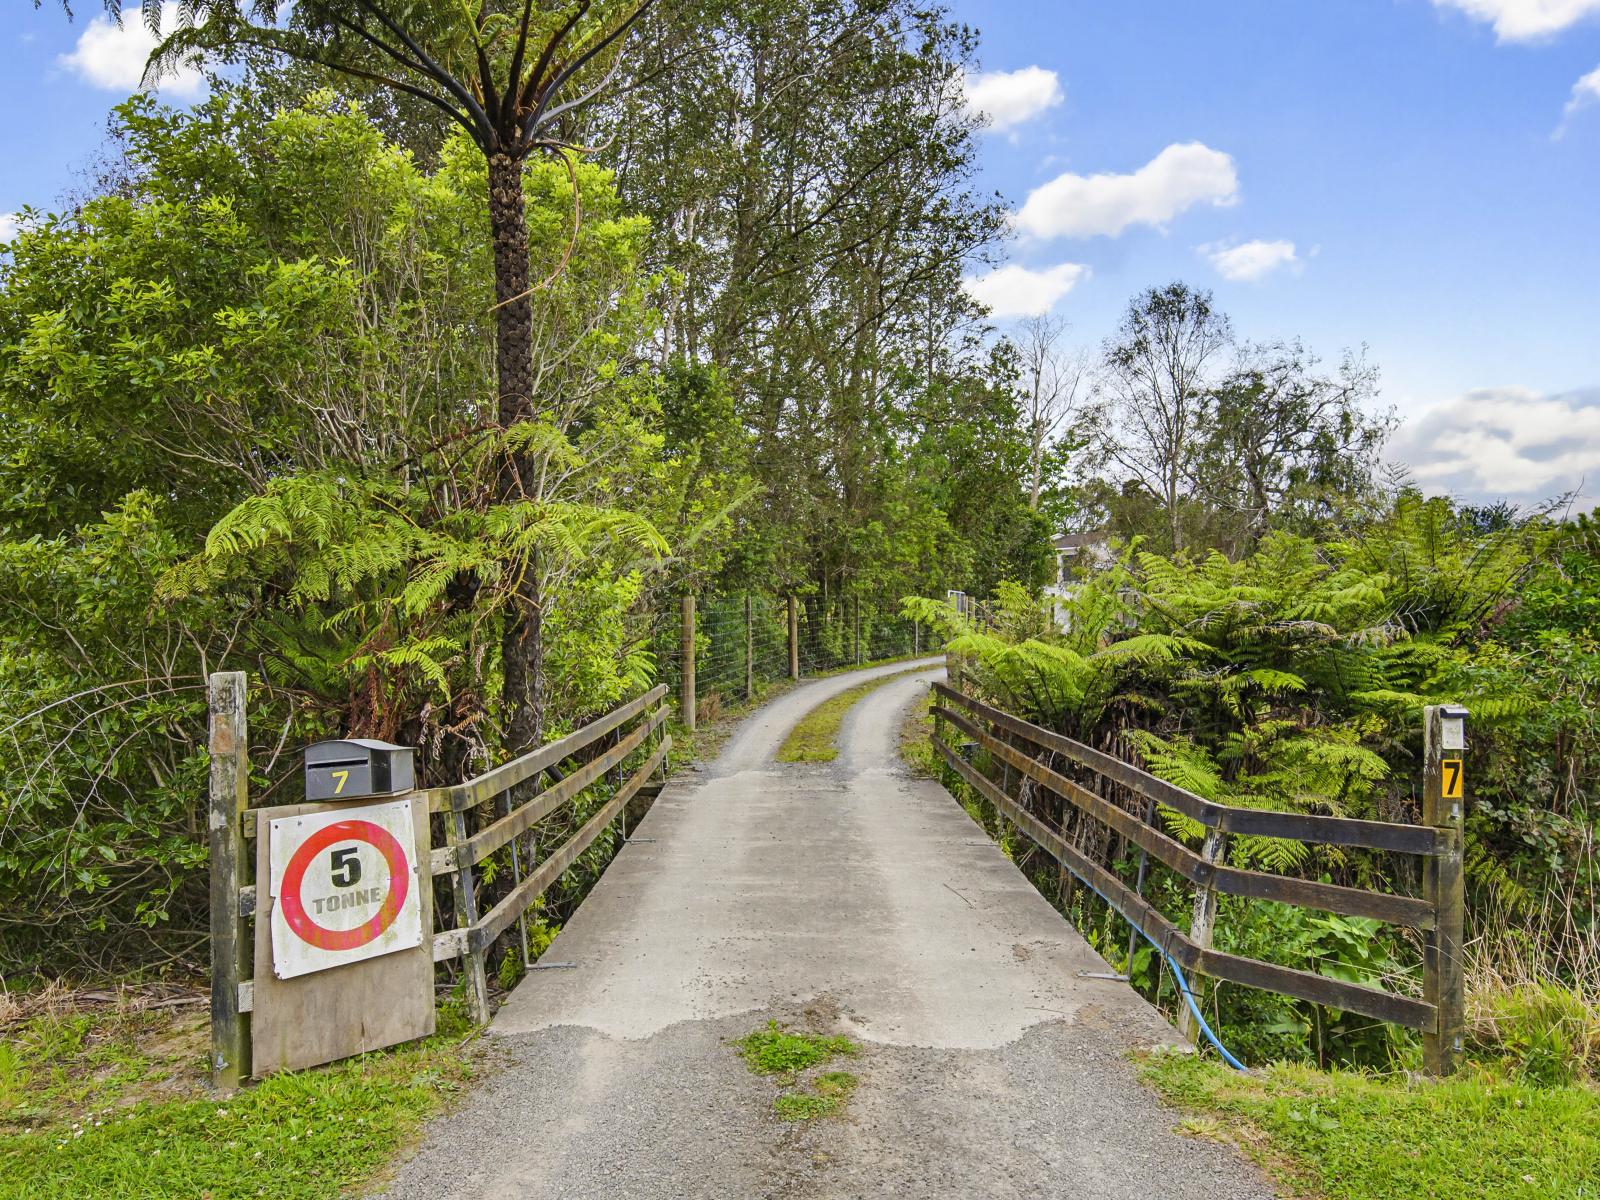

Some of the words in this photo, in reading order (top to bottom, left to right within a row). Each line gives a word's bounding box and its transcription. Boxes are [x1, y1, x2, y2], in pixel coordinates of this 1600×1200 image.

[332, 770, 349, 794] 7
[1444, 761, 1461, 796] 7
[330, 846, 362, 888] 5
[312, 887, 381, 915] TONNE
